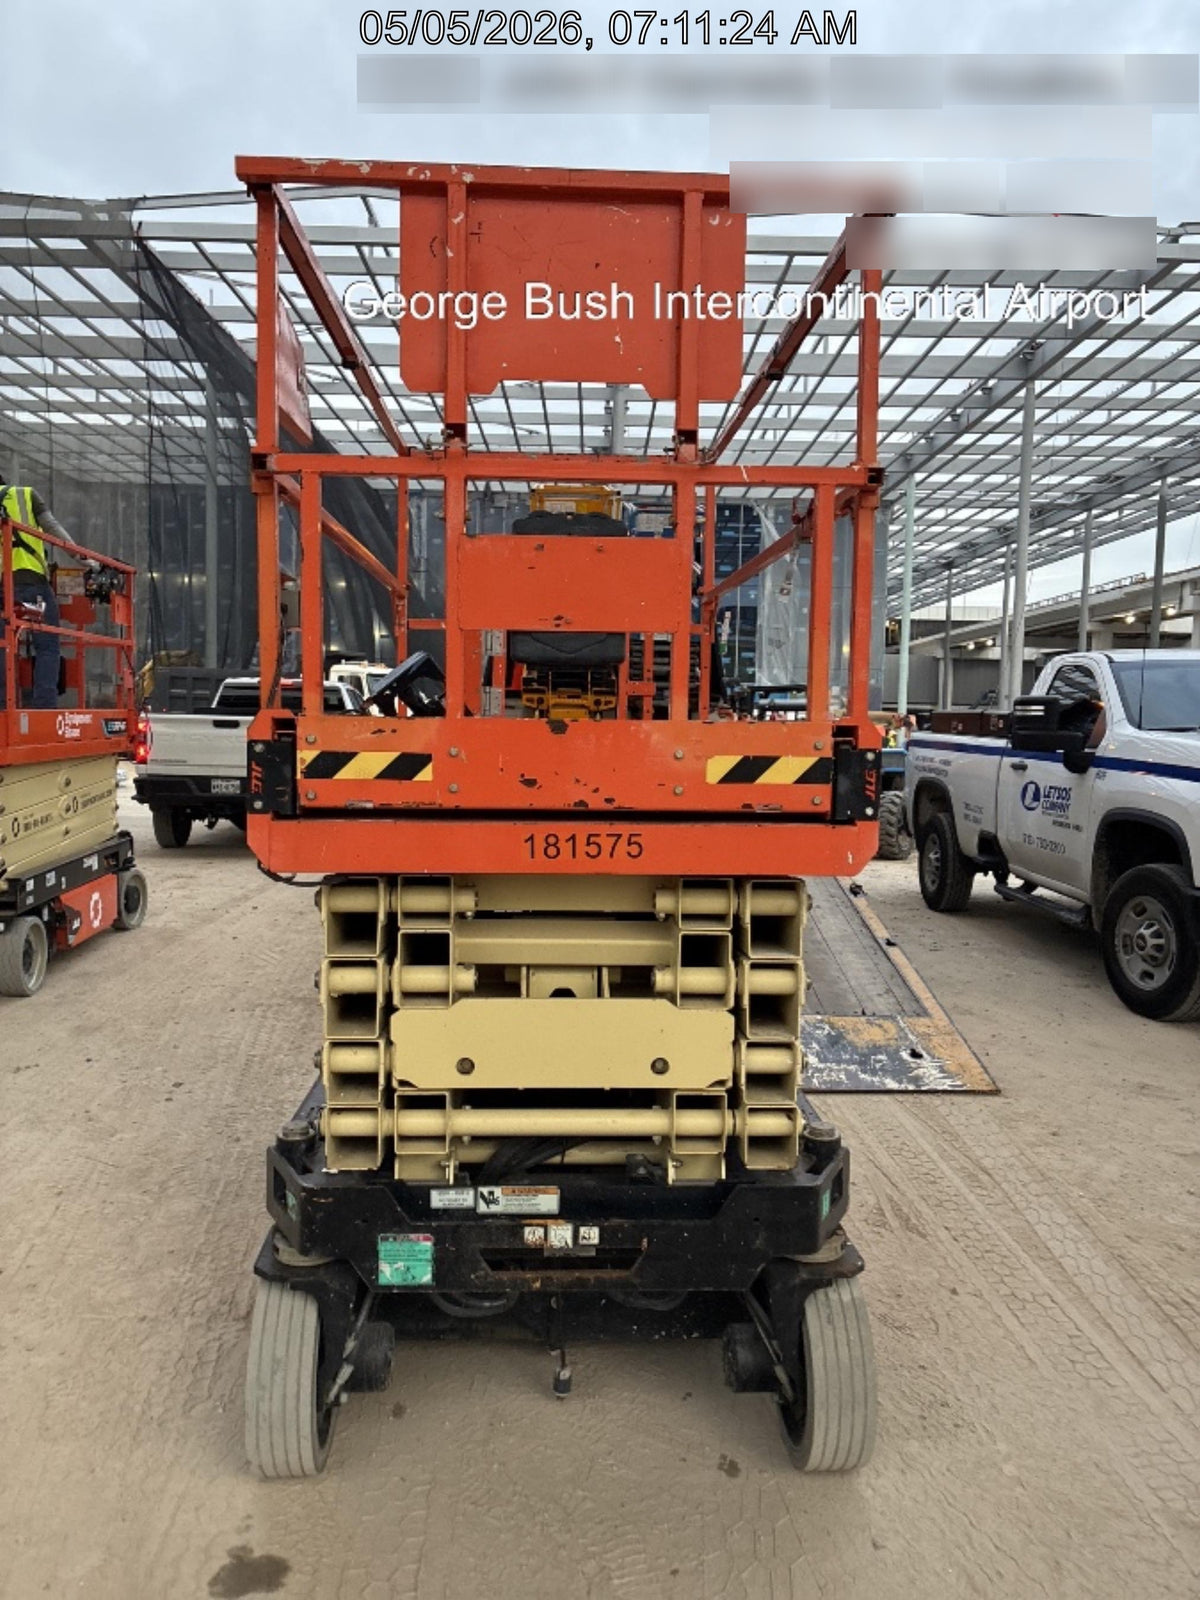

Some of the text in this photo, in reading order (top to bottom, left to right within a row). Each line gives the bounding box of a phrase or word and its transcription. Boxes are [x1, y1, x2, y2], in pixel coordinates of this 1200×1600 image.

[250, 760, 263, 796] JLG
[864, 768, 877, 801] JLG
[523, 832, 644, 860] 181575
